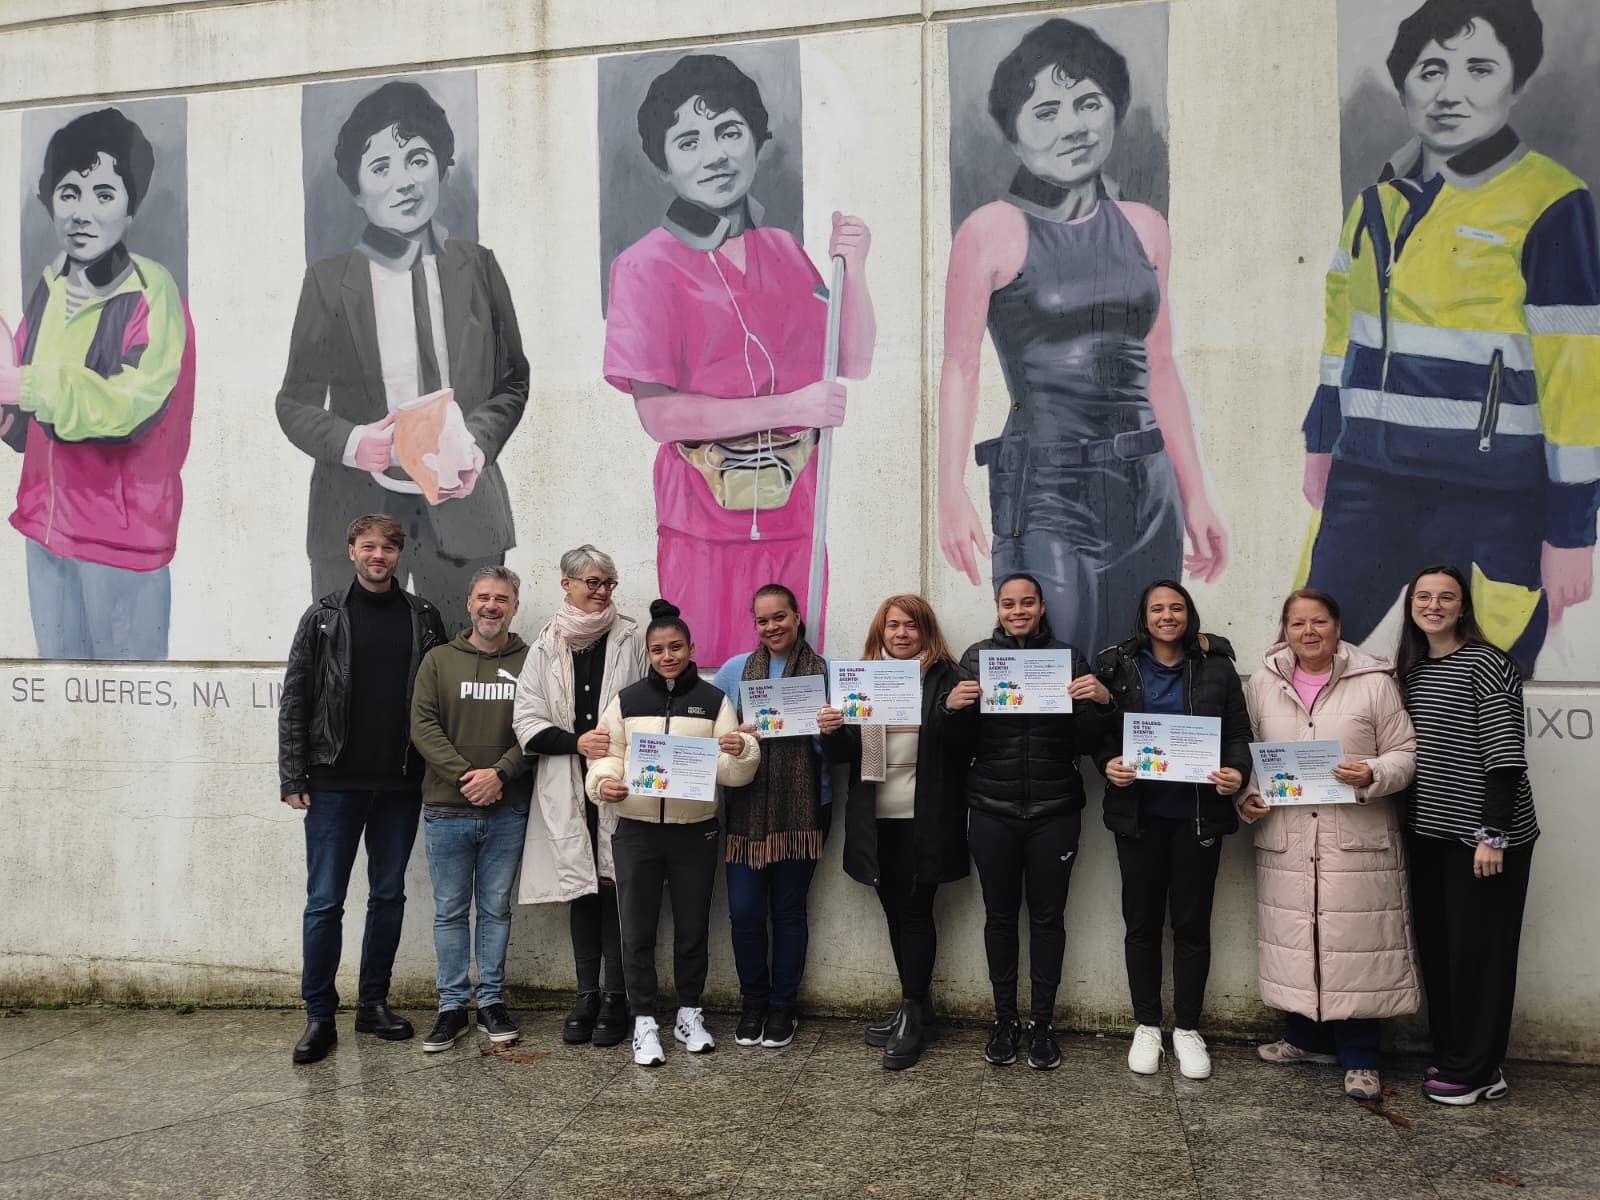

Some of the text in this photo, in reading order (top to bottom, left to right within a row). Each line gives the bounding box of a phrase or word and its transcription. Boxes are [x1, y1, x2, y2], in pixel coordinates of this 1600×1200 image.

[12, 677, 45, 702] SE
[65, 677, 177, 709] QUERES,
[193, 681, 230, 708] NA
[460, 682, 515, 700] PUMA
